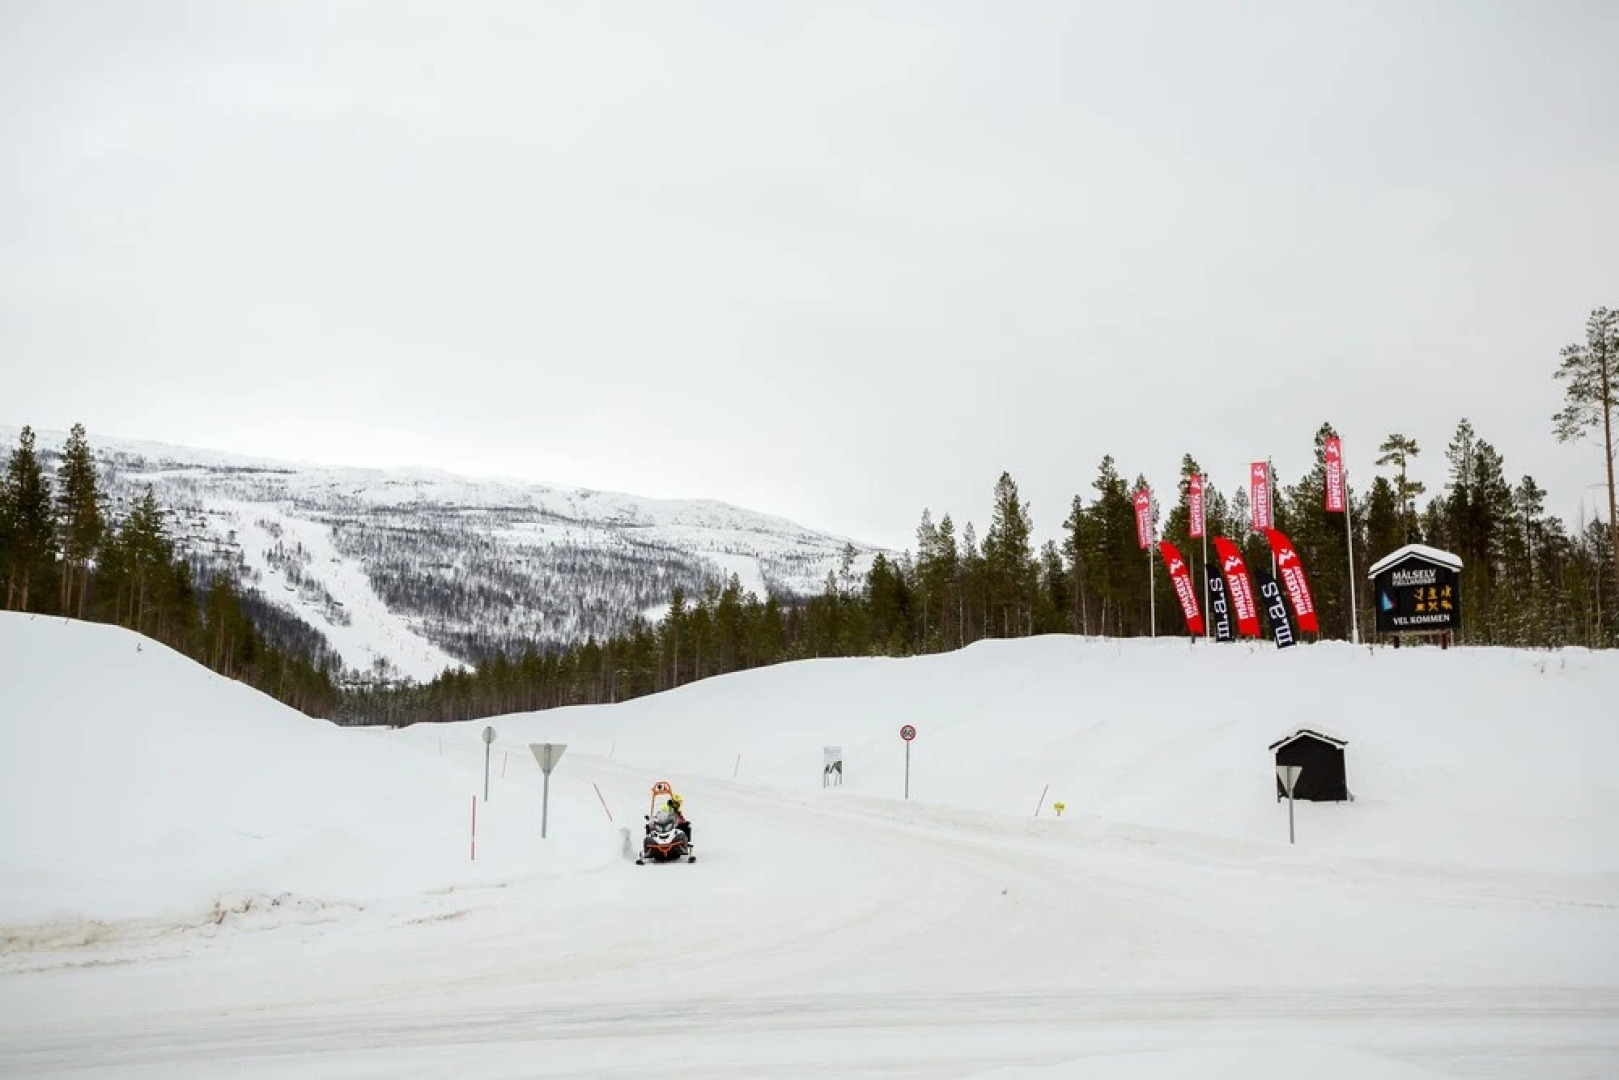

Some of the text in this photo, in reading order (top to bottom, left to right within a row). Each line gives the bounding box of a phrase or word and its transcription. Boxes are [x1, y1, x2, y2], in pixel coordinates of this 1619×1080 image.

[1392, 569, 1436, 579] MÅLSELV
[1209, 577, 1230, 638] m.a.s
[1261, 582, 1293, 645] m.a.s
